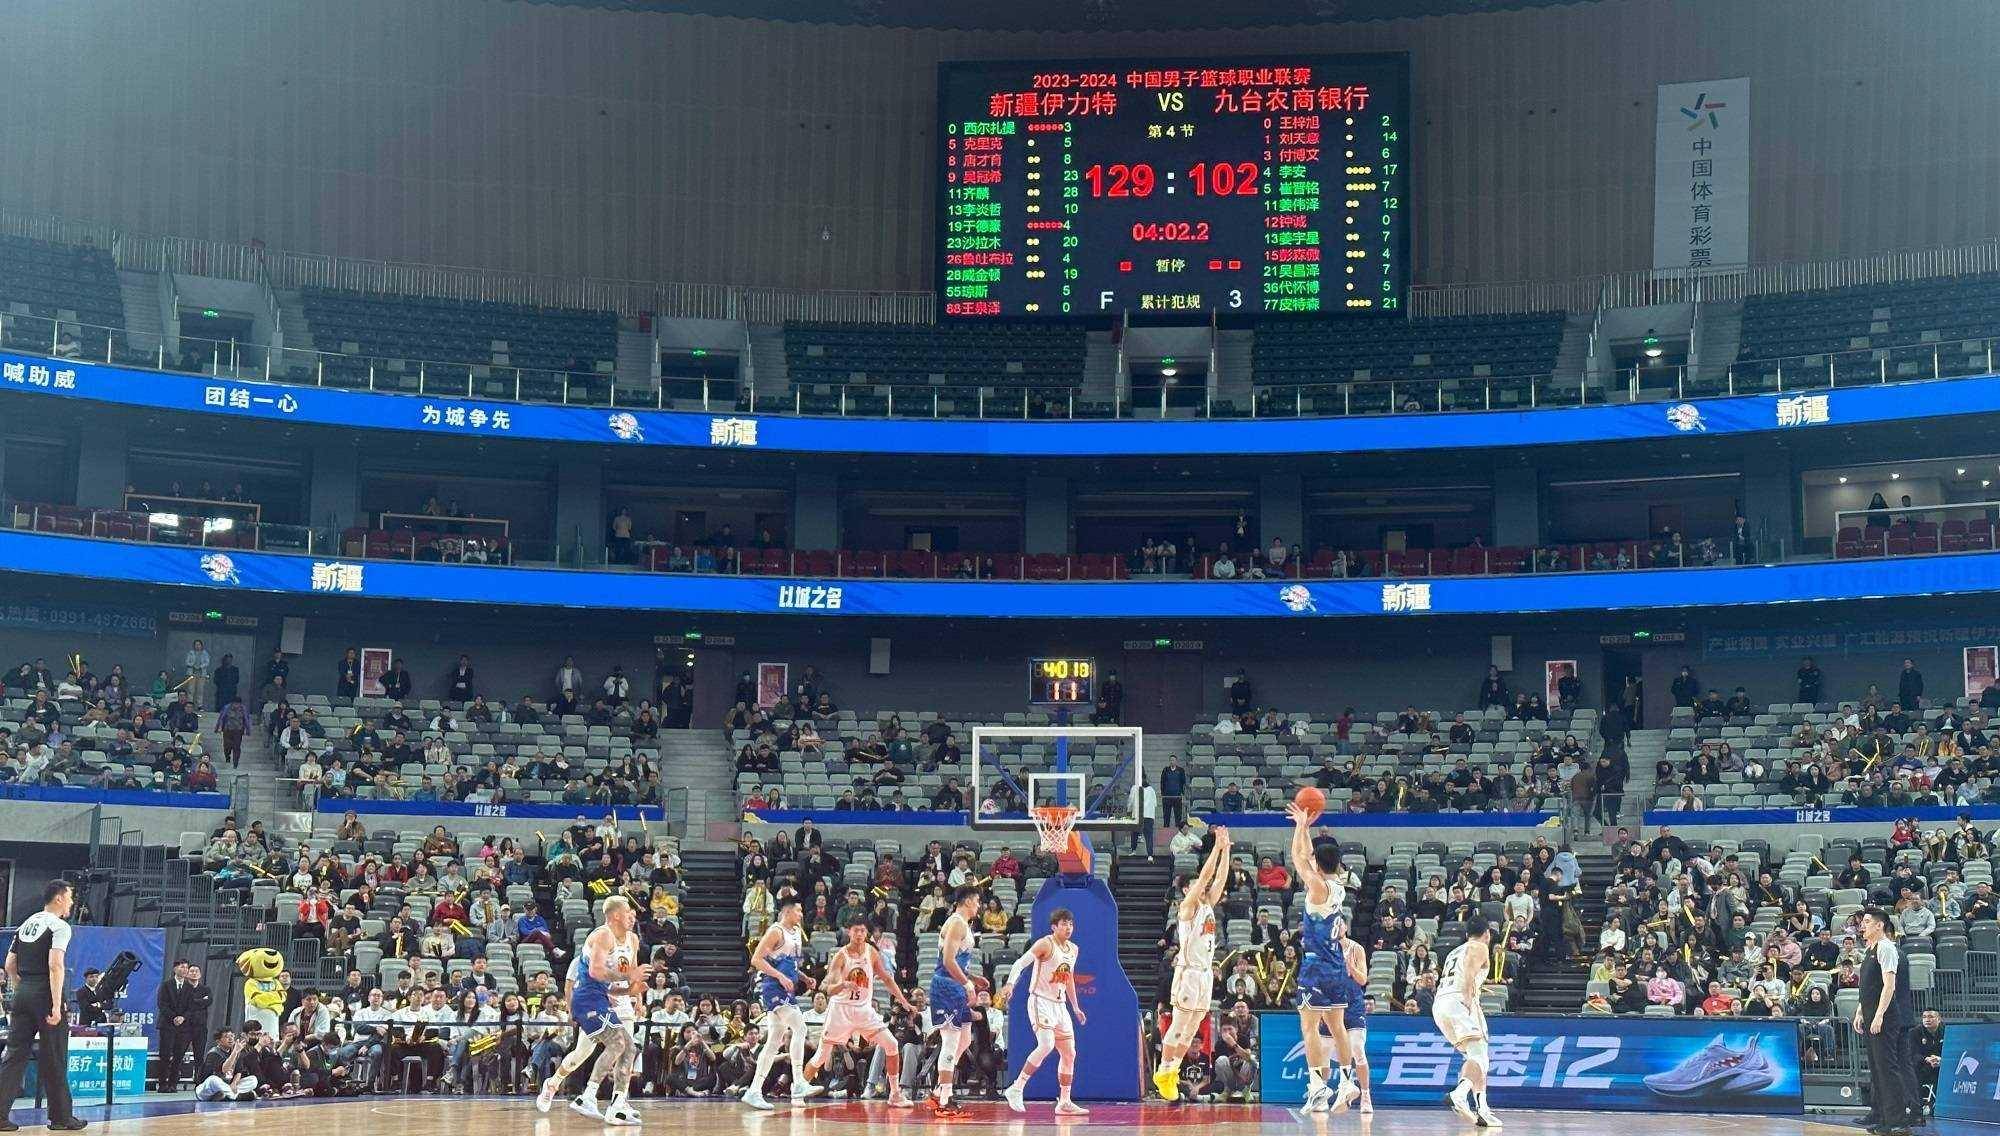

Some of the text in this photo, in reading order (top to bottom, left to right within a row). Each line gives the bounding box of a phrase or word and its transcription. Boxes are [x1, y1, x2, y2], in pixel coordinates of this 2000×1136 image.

[1034, 68, 1311, 89] 2023-2024 中国男子篮球职业联赛
[990, 86, 1370, 116] 新疆伊力特 VS 九台农商银行
[1063, 122, 1071, 132] 3
[1264, 118, 1271, 129] 0
[1382, 116, 1389, 126] 2
[1167, 126, 1175, 137] 4
[1383, 132, 1397, 141] 14
[1064, 137, 1071, 147] 5
[1064, 154, 1071, 164] 8
[1264, 151, 1271, 160] 3
[1382, 148, 1389, 158] 6
[1064, 170, 1078, 181] 23
[1263, 167, 1271, 177] 4
[1383, 164, 1397, 175] 17
[1086, 165, 1154, 196] 129
[1189, 163, 1258, 195] 102
[1064, 187, 1078, 197] 28
[1264, 184, 1271, 194] 5
[1382, 181, 1389, 191] 7
[1065, 203, 1078, 213] 10
[1383, 198, 1397, 208] 12
[1690, 137, 1713, 268] 中国体育彩票
[1063, 220, 1070, 230] 4
[1383, 215, 1390, 225] 0
[1132, 223, 1209, 241] 04:02.2
[1383, 231, 1390, 242] 7
[1063, 234, 1078, 247] 20
[1063, 253, 1070, 263] 4
[1382, 247, 1391, 259] 4
[1156, 259, 1185, 273] 暂停
[1383, 264, 1390, 274] 7
[1064, 269, 1077, 279] 19
[1063, 285, 1070, 295] 5
[1383, 281, 1390, 291] 5
[1101, 290, 1242, 310] F 累计犯规 3
[1383, 298, 1396, 308] 21
[1063, 302, 1070, 312] 0
[2, 362, 77, 391] 喊助威
[205, 386, 298, 413] 团结一心
[1777, 395, 1829, 426] 新疆
[422, 405, 511, 430] 为城争先
[710, 417, 757, 446] 新疆
[311, 561, 363, 592] 新疆
[779, 585, 842, 608] 以城之名
[1382, 583, 1431, 612] 新疆
[850, 990, 861, 1000] 15
[69, 1055, 93, 1073] 医疗
